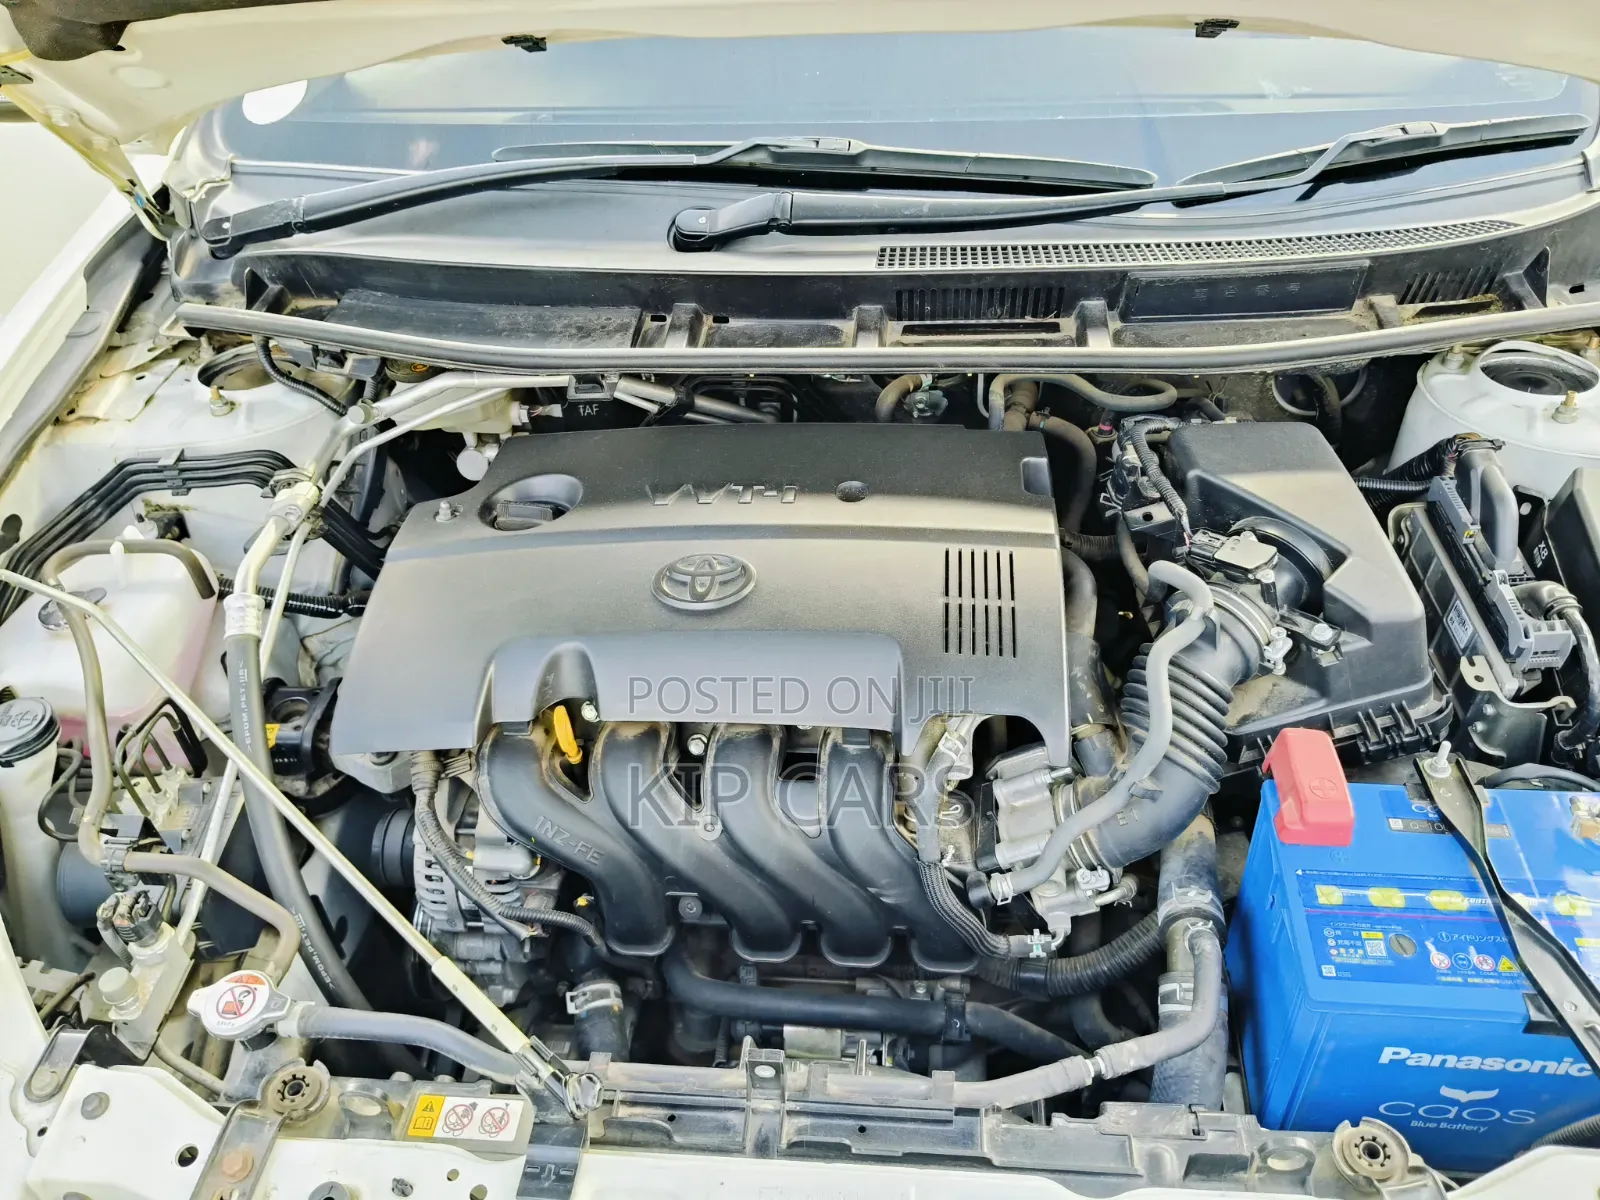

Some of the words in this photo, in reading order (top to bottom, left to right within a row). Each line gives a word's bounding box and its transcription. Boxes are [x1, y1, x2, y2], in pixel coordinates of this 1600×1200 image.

[578, 403, 599, 416] TAF
[535, 815, 604, 866] 1NZ-FE
[1378, 1046, 1593, 1077] Panasonic
[1378, 1101, 1536, 1125] caos
[1410, 1120, 1437, 1129] Blue
[1438, 1121, 1489, 1133] Battery
